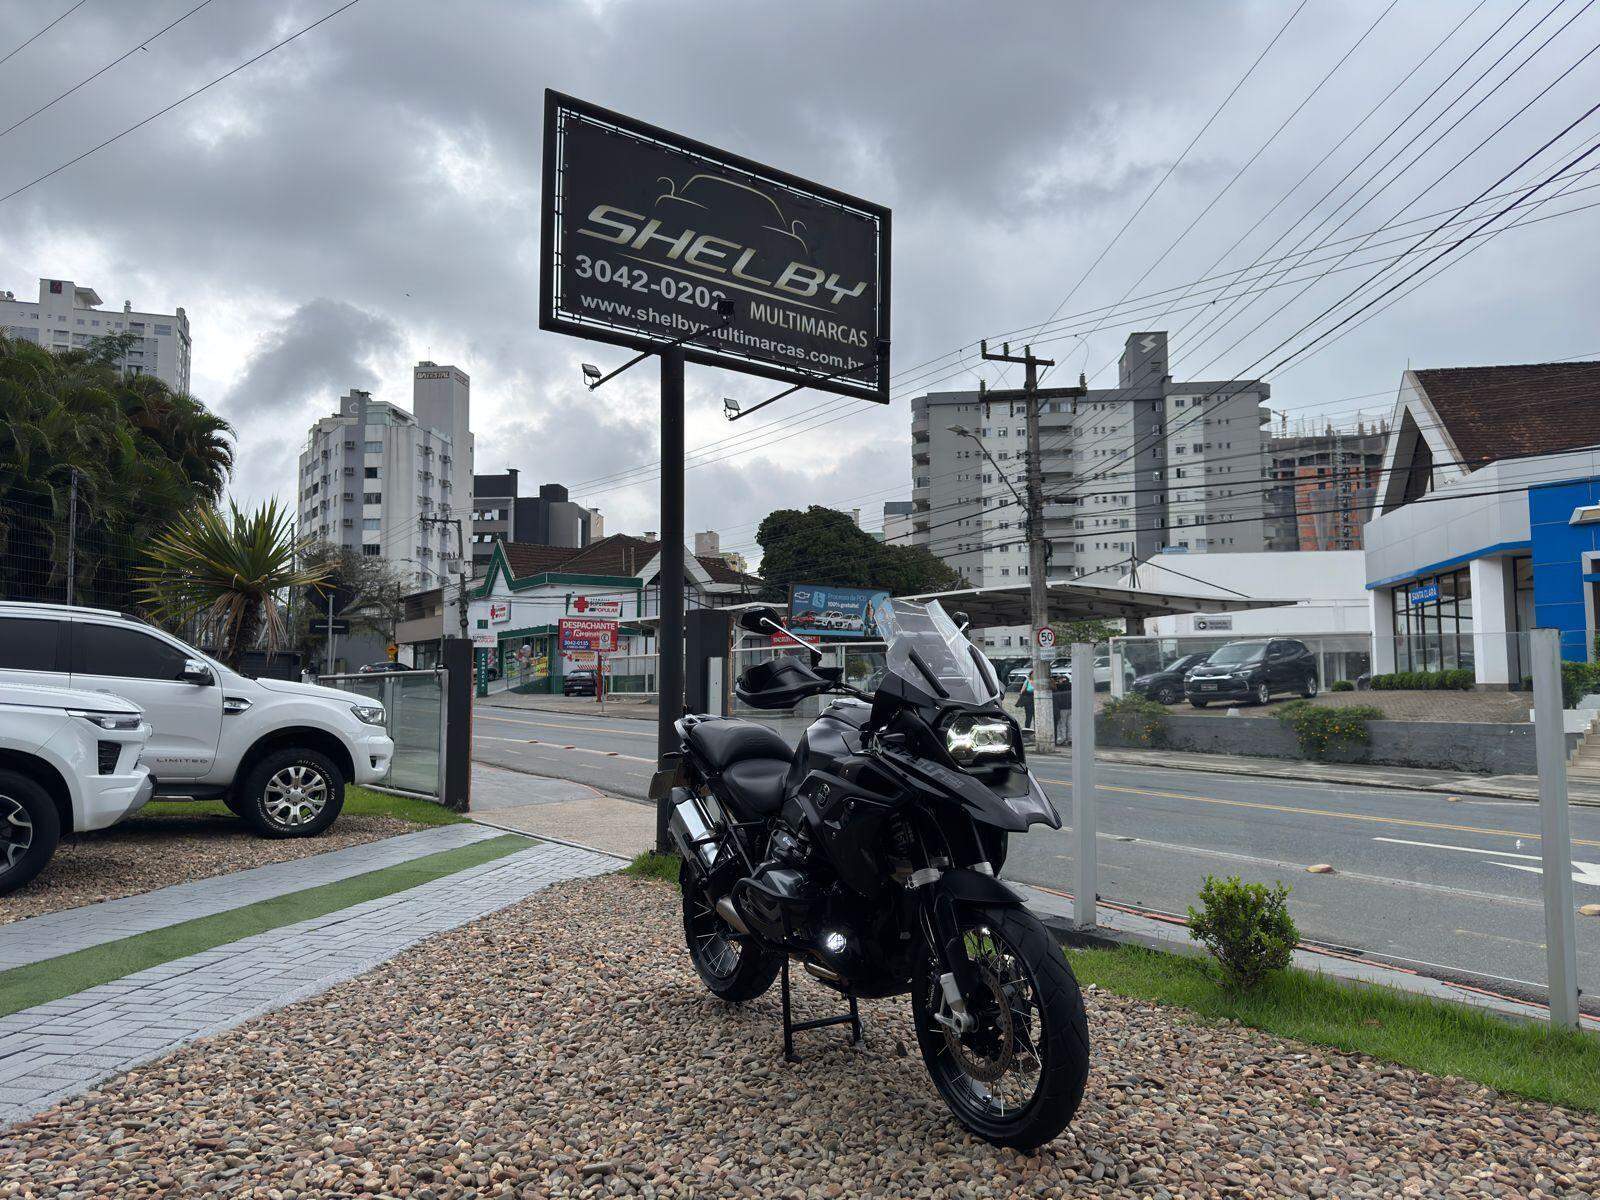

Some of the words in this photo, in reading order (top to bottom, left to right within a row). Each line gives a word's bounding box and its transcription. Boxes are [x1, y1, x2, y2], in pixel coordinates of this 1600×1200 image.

[577, 204, 868, 305] SHELBY
[750, 301, 868, 348] MULTIMARCAS
[563, 621, 615, 631] DESPACHANTE
[1041, 632, 1053, 642] 50
